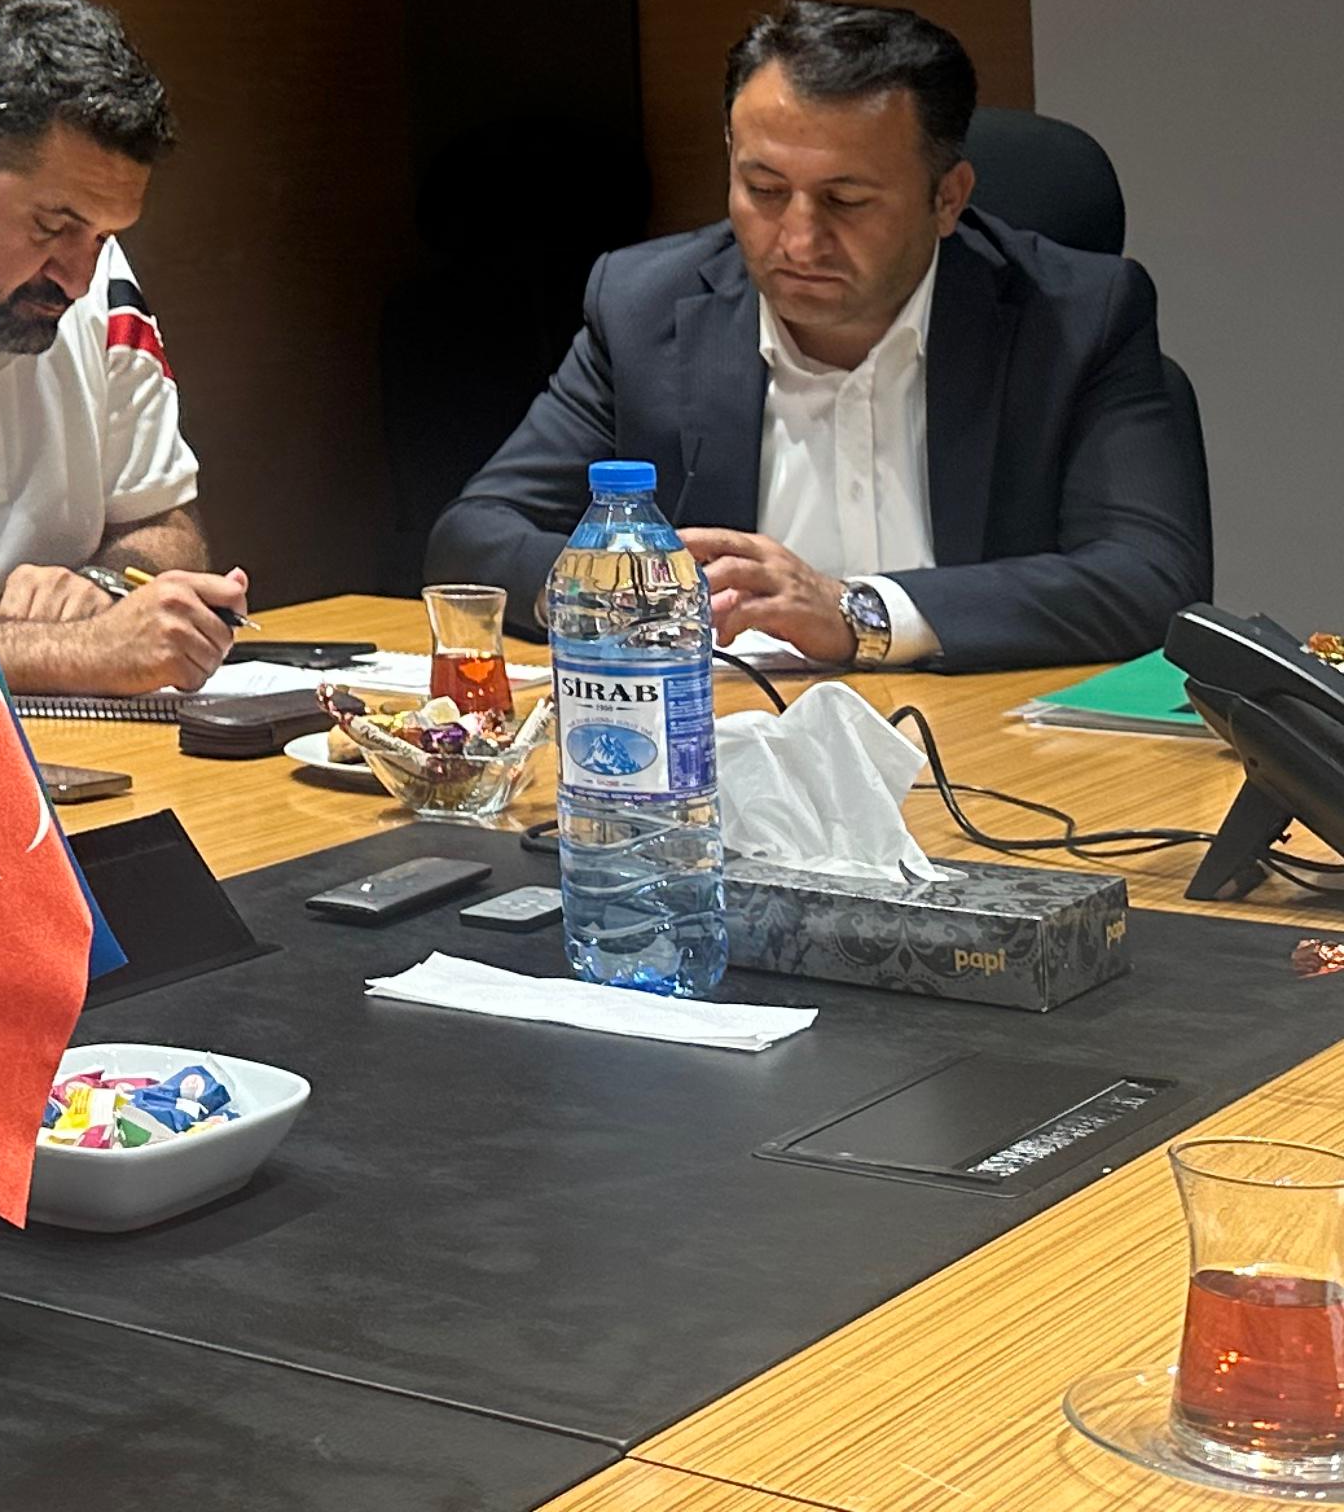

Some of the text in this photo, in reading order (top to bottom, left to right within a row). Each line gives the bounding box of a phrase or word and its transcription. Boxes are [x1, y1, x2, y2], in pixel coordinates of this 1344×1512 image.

[562, 677, 659, 703] SİRAB
[1106, 912, 1127, 950] papi
[954, 948, 1006, 976] papi
